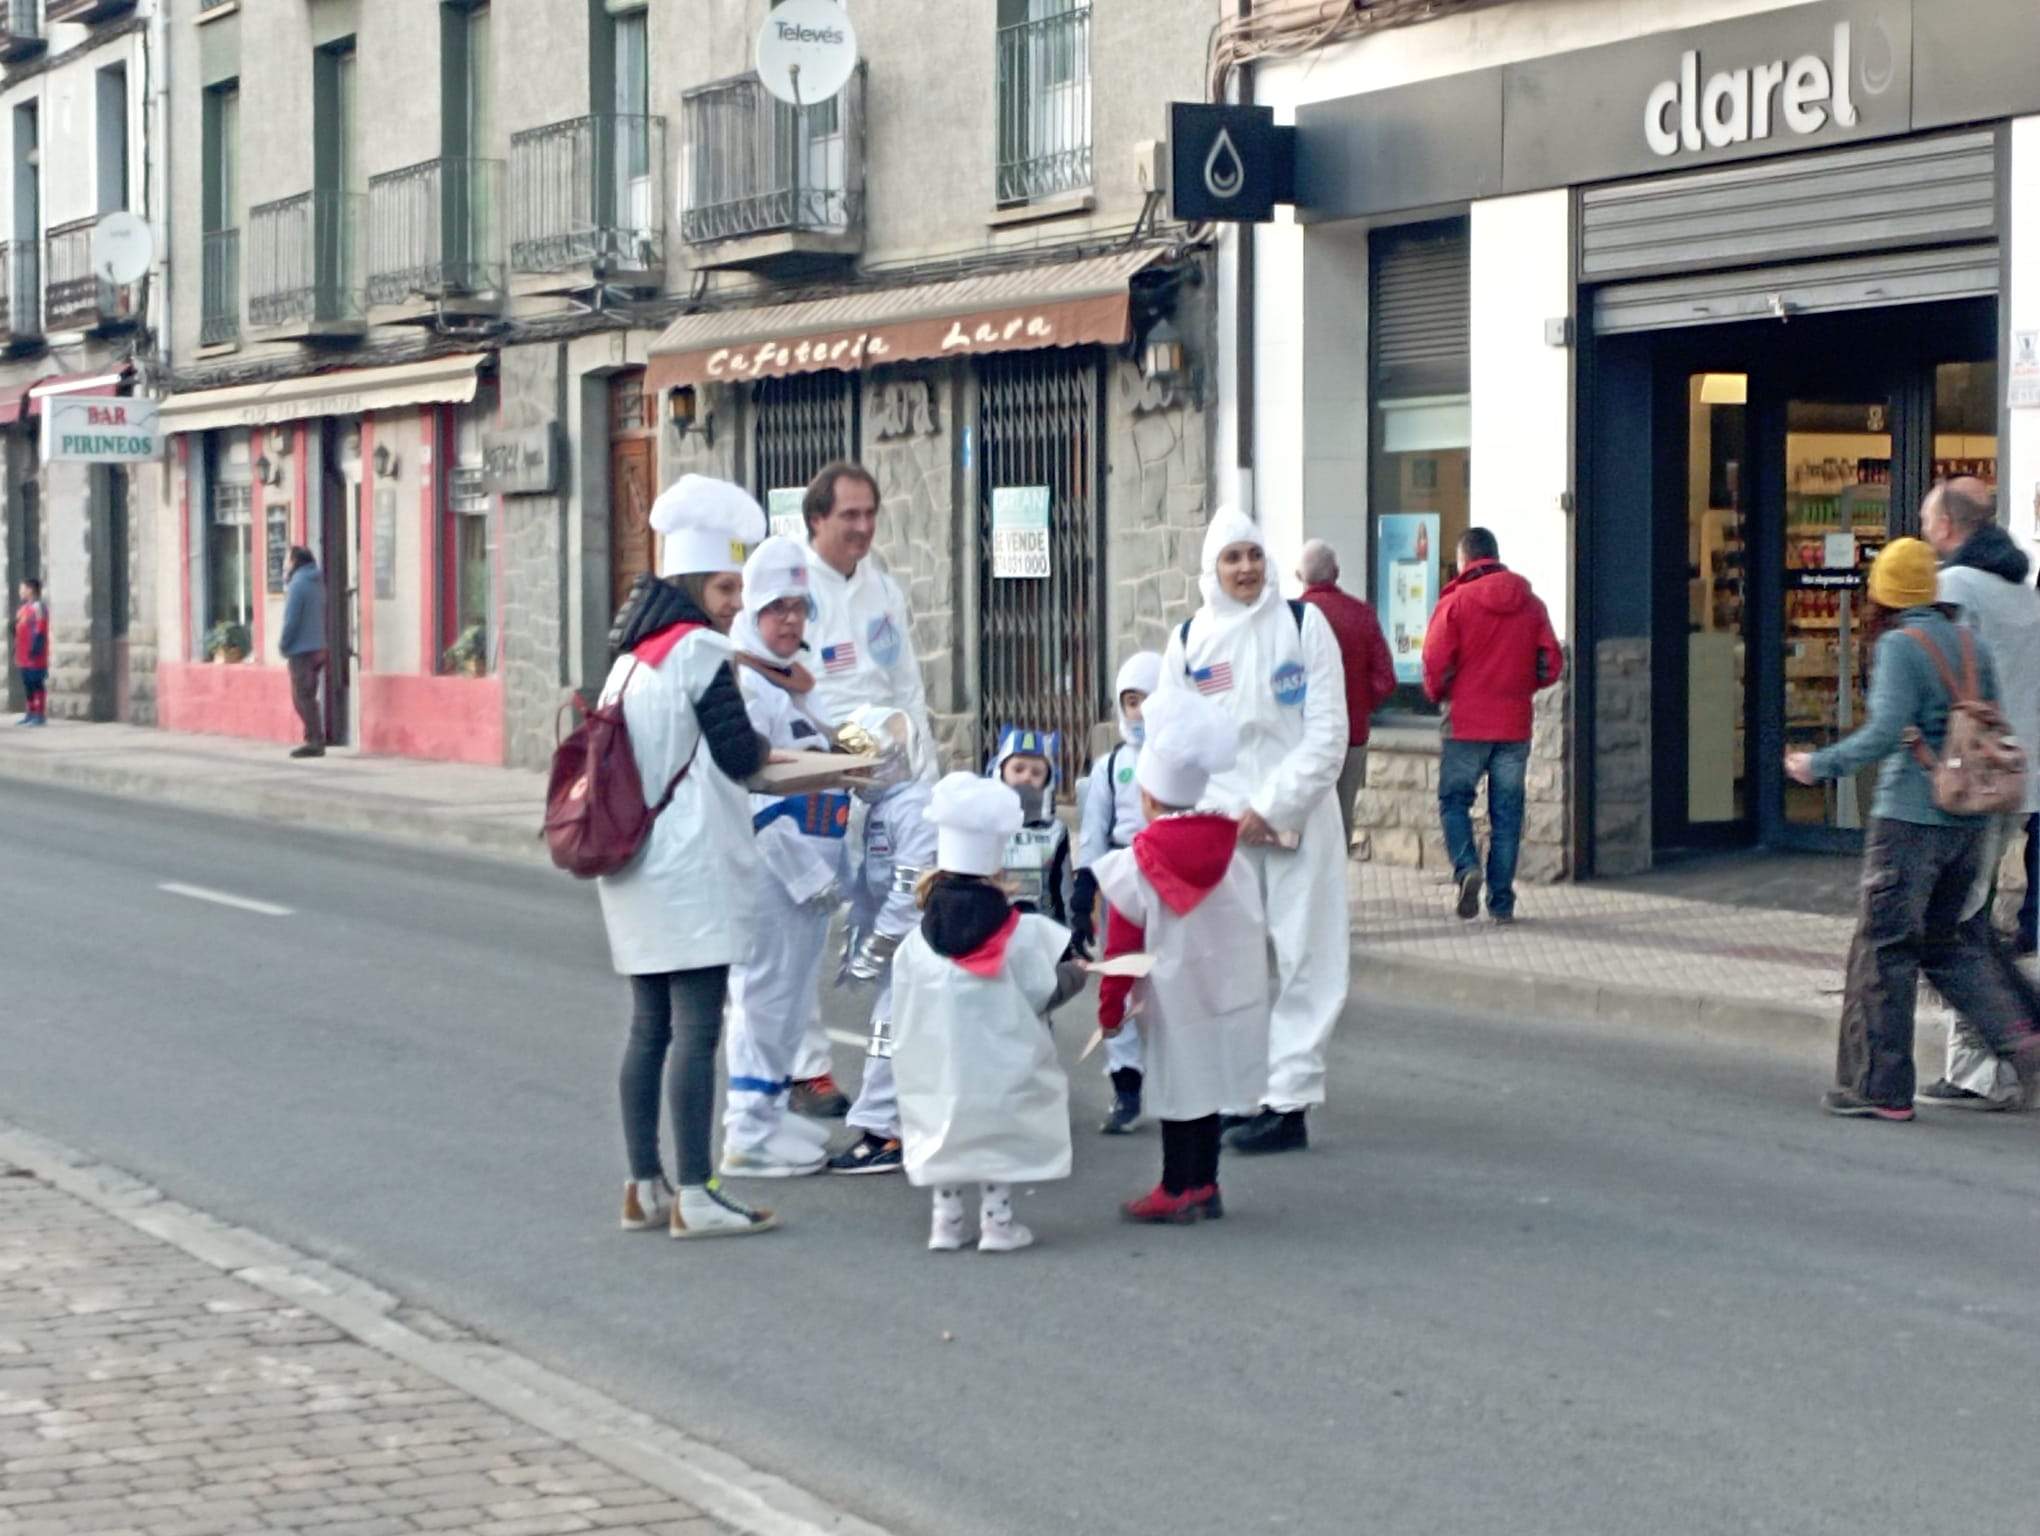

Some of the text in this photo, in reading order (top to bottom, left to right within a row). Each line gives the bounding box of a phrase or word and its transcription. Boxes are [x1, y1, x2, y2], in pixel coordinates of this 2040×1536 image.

[774, 21, 844, 44] Televés
[1644, 21, 1857, 156] clarel
[941, 316, 1052, 350] Lara
[87, 405, 127, 425] BAR
[62, 435, 152, 455] PIRINEOS
[1006, 531, 1046, 552] VENDE
